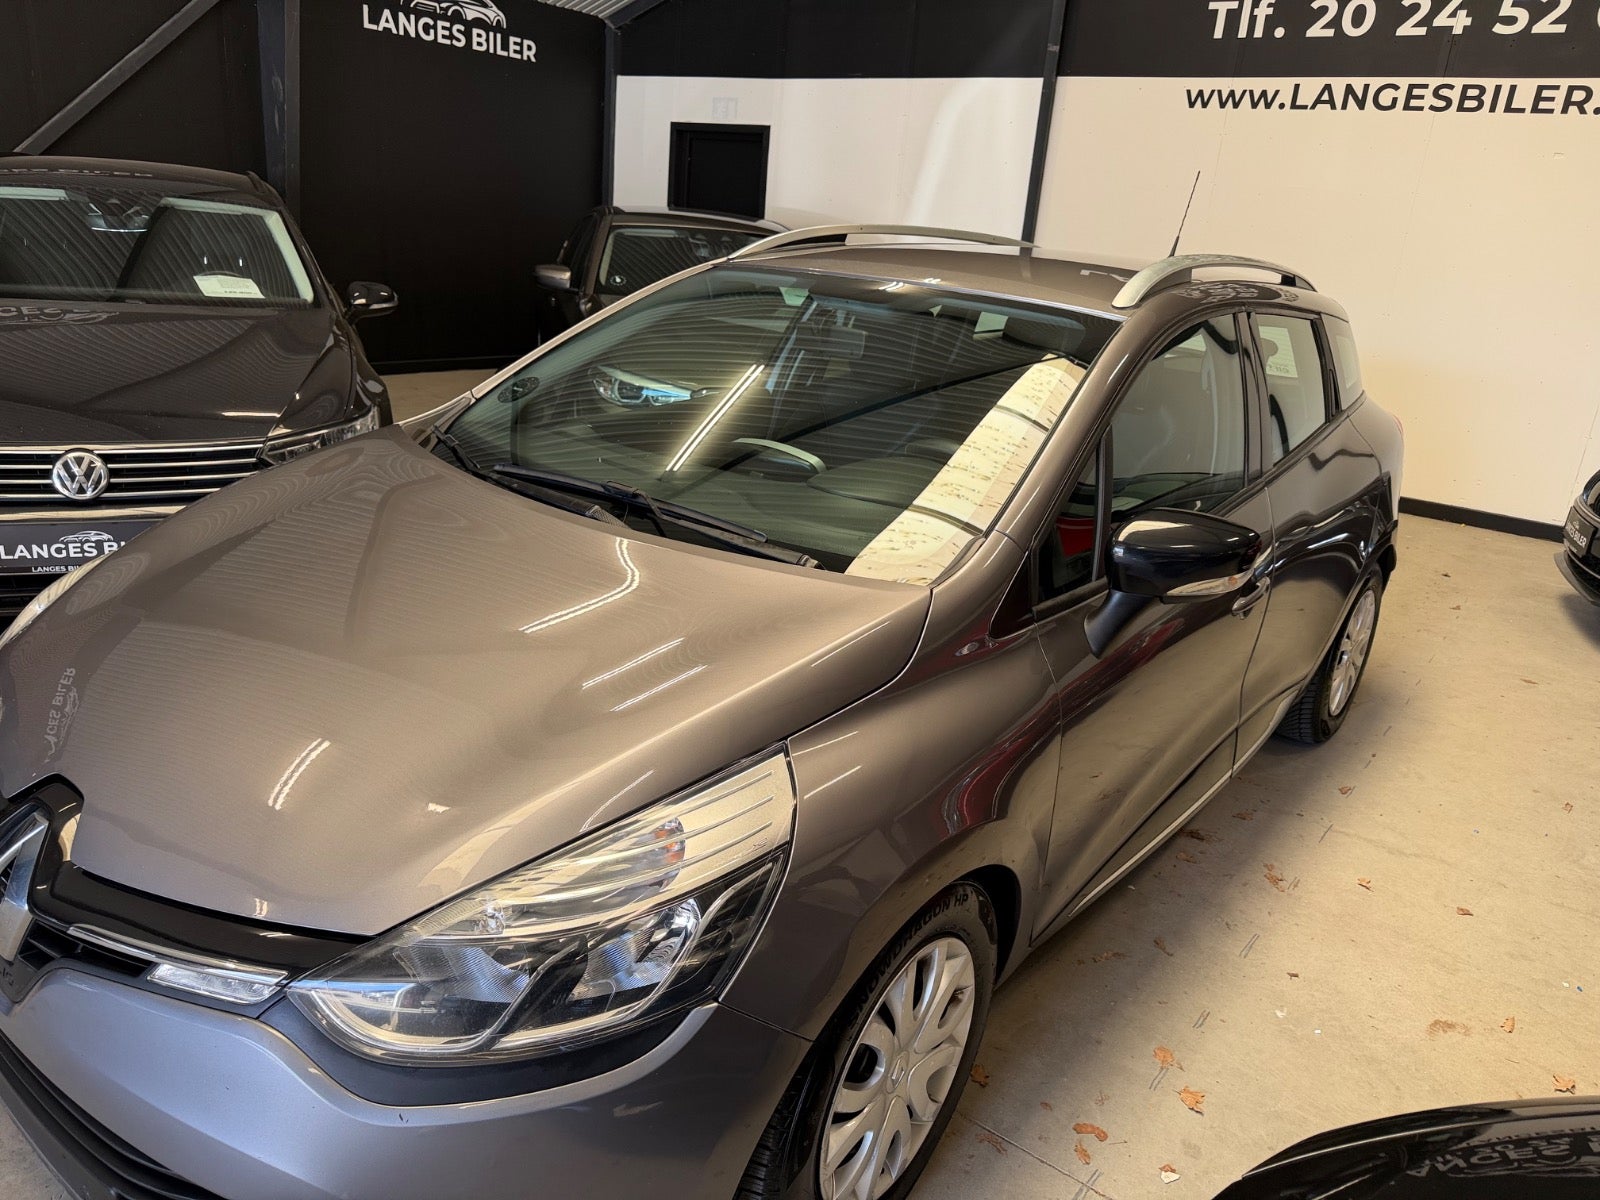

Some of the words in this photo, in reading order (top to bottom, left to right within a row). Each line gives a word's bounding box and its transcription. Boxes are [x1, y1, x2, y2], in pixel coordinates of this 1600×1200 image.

[1208, 0, 1286, 39] Tlf.
[1306, 0, 1376, 37] 20
[1396, 0, 1473, 37] 24
[1491, 0, 1572, 35] 52
[363, 4, 466, 48] LANGES
[472, 28, 537, 62] BILER
[0, 541, 98, 560] LANGES
[32, 565, 66, 573] LANGES
[953, 892, 969, 908] HP
